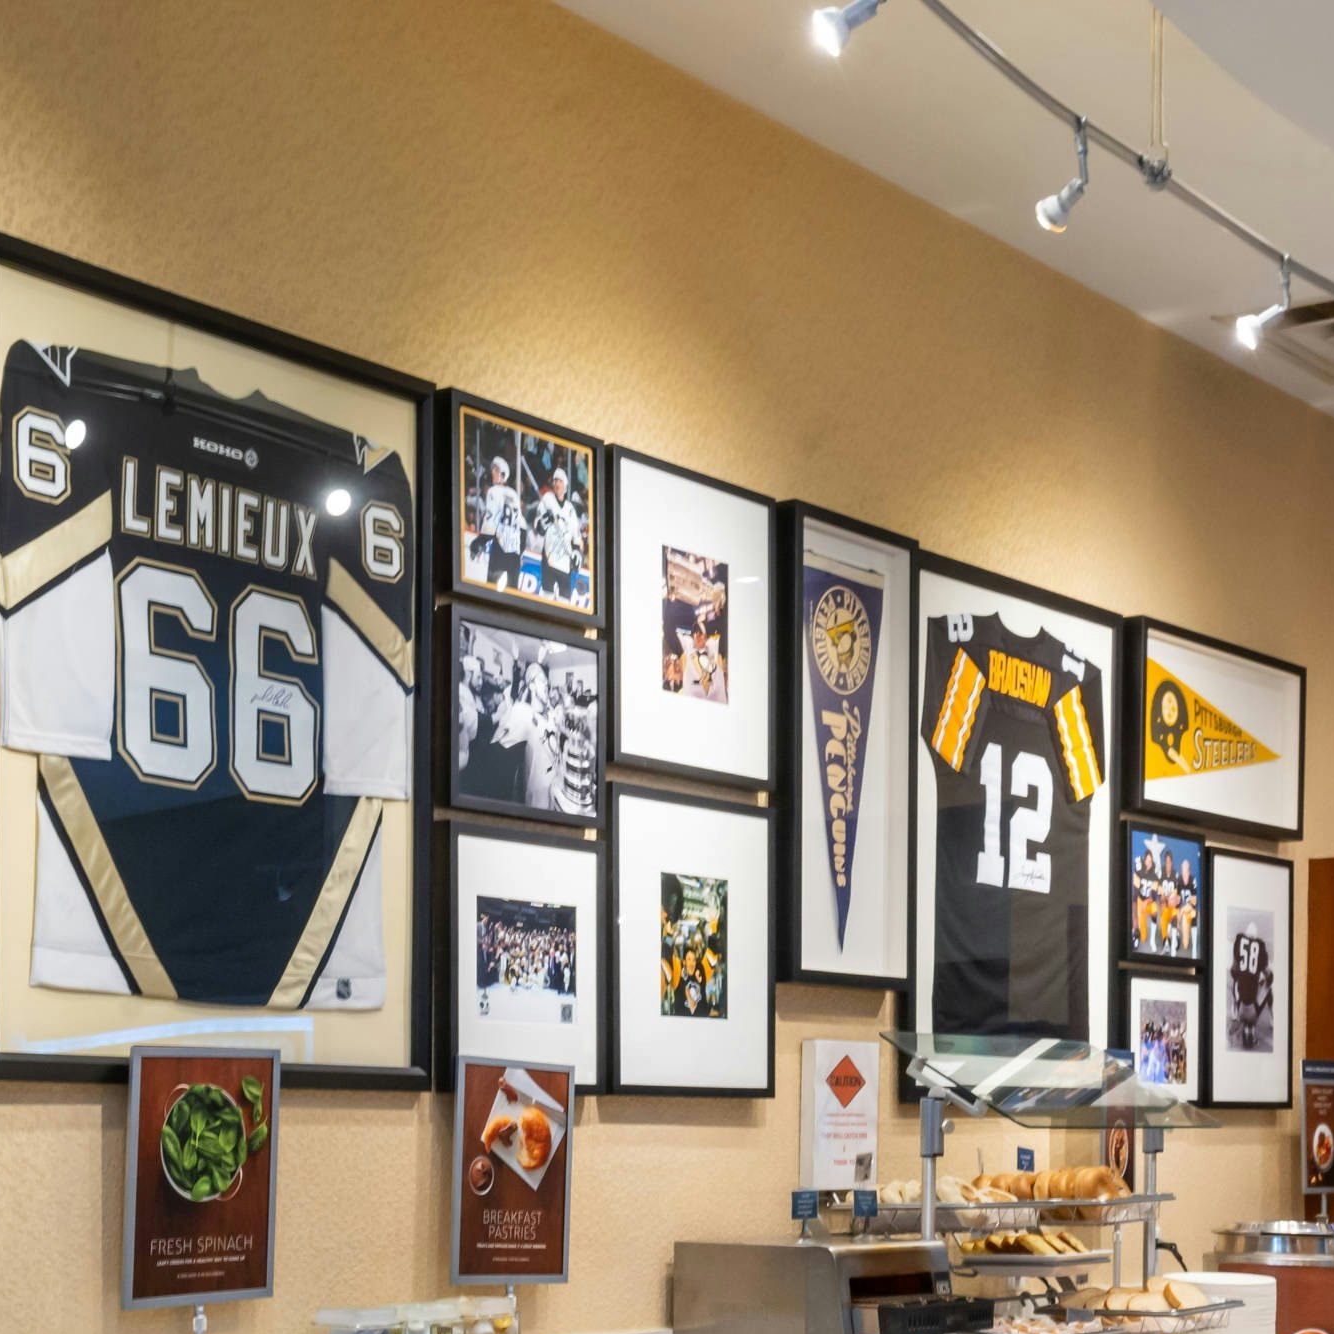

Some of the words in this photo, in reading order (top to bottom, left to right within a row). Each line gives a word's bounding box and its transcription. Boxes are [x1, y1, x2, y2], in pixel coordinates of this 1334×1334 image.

[12, 405, 72, 505] 6
[120, 455, 320, 581] LEMIEUX
[360, 500, 405, 584] 6
[113, 555, 321, 807] 66
[987, 649, 1052, 709] BRADSHAW
[1193, 698, 1243, 738] PITTSBURGH
[1192, 727, 1257, 770] STEELERS
[821, 709, 848, 888] PENGUINS
[975, 742, 1054, 894] 12
[1239, 936, 1260, 974] 58
[150, 1237, 192, 1256] FRESH
[197, 1234, 253, 1254] SPINACH
[482, 1209, 542, 1225] BREAKFAST
[488, 1224, 536, 1240] PASTRIES
